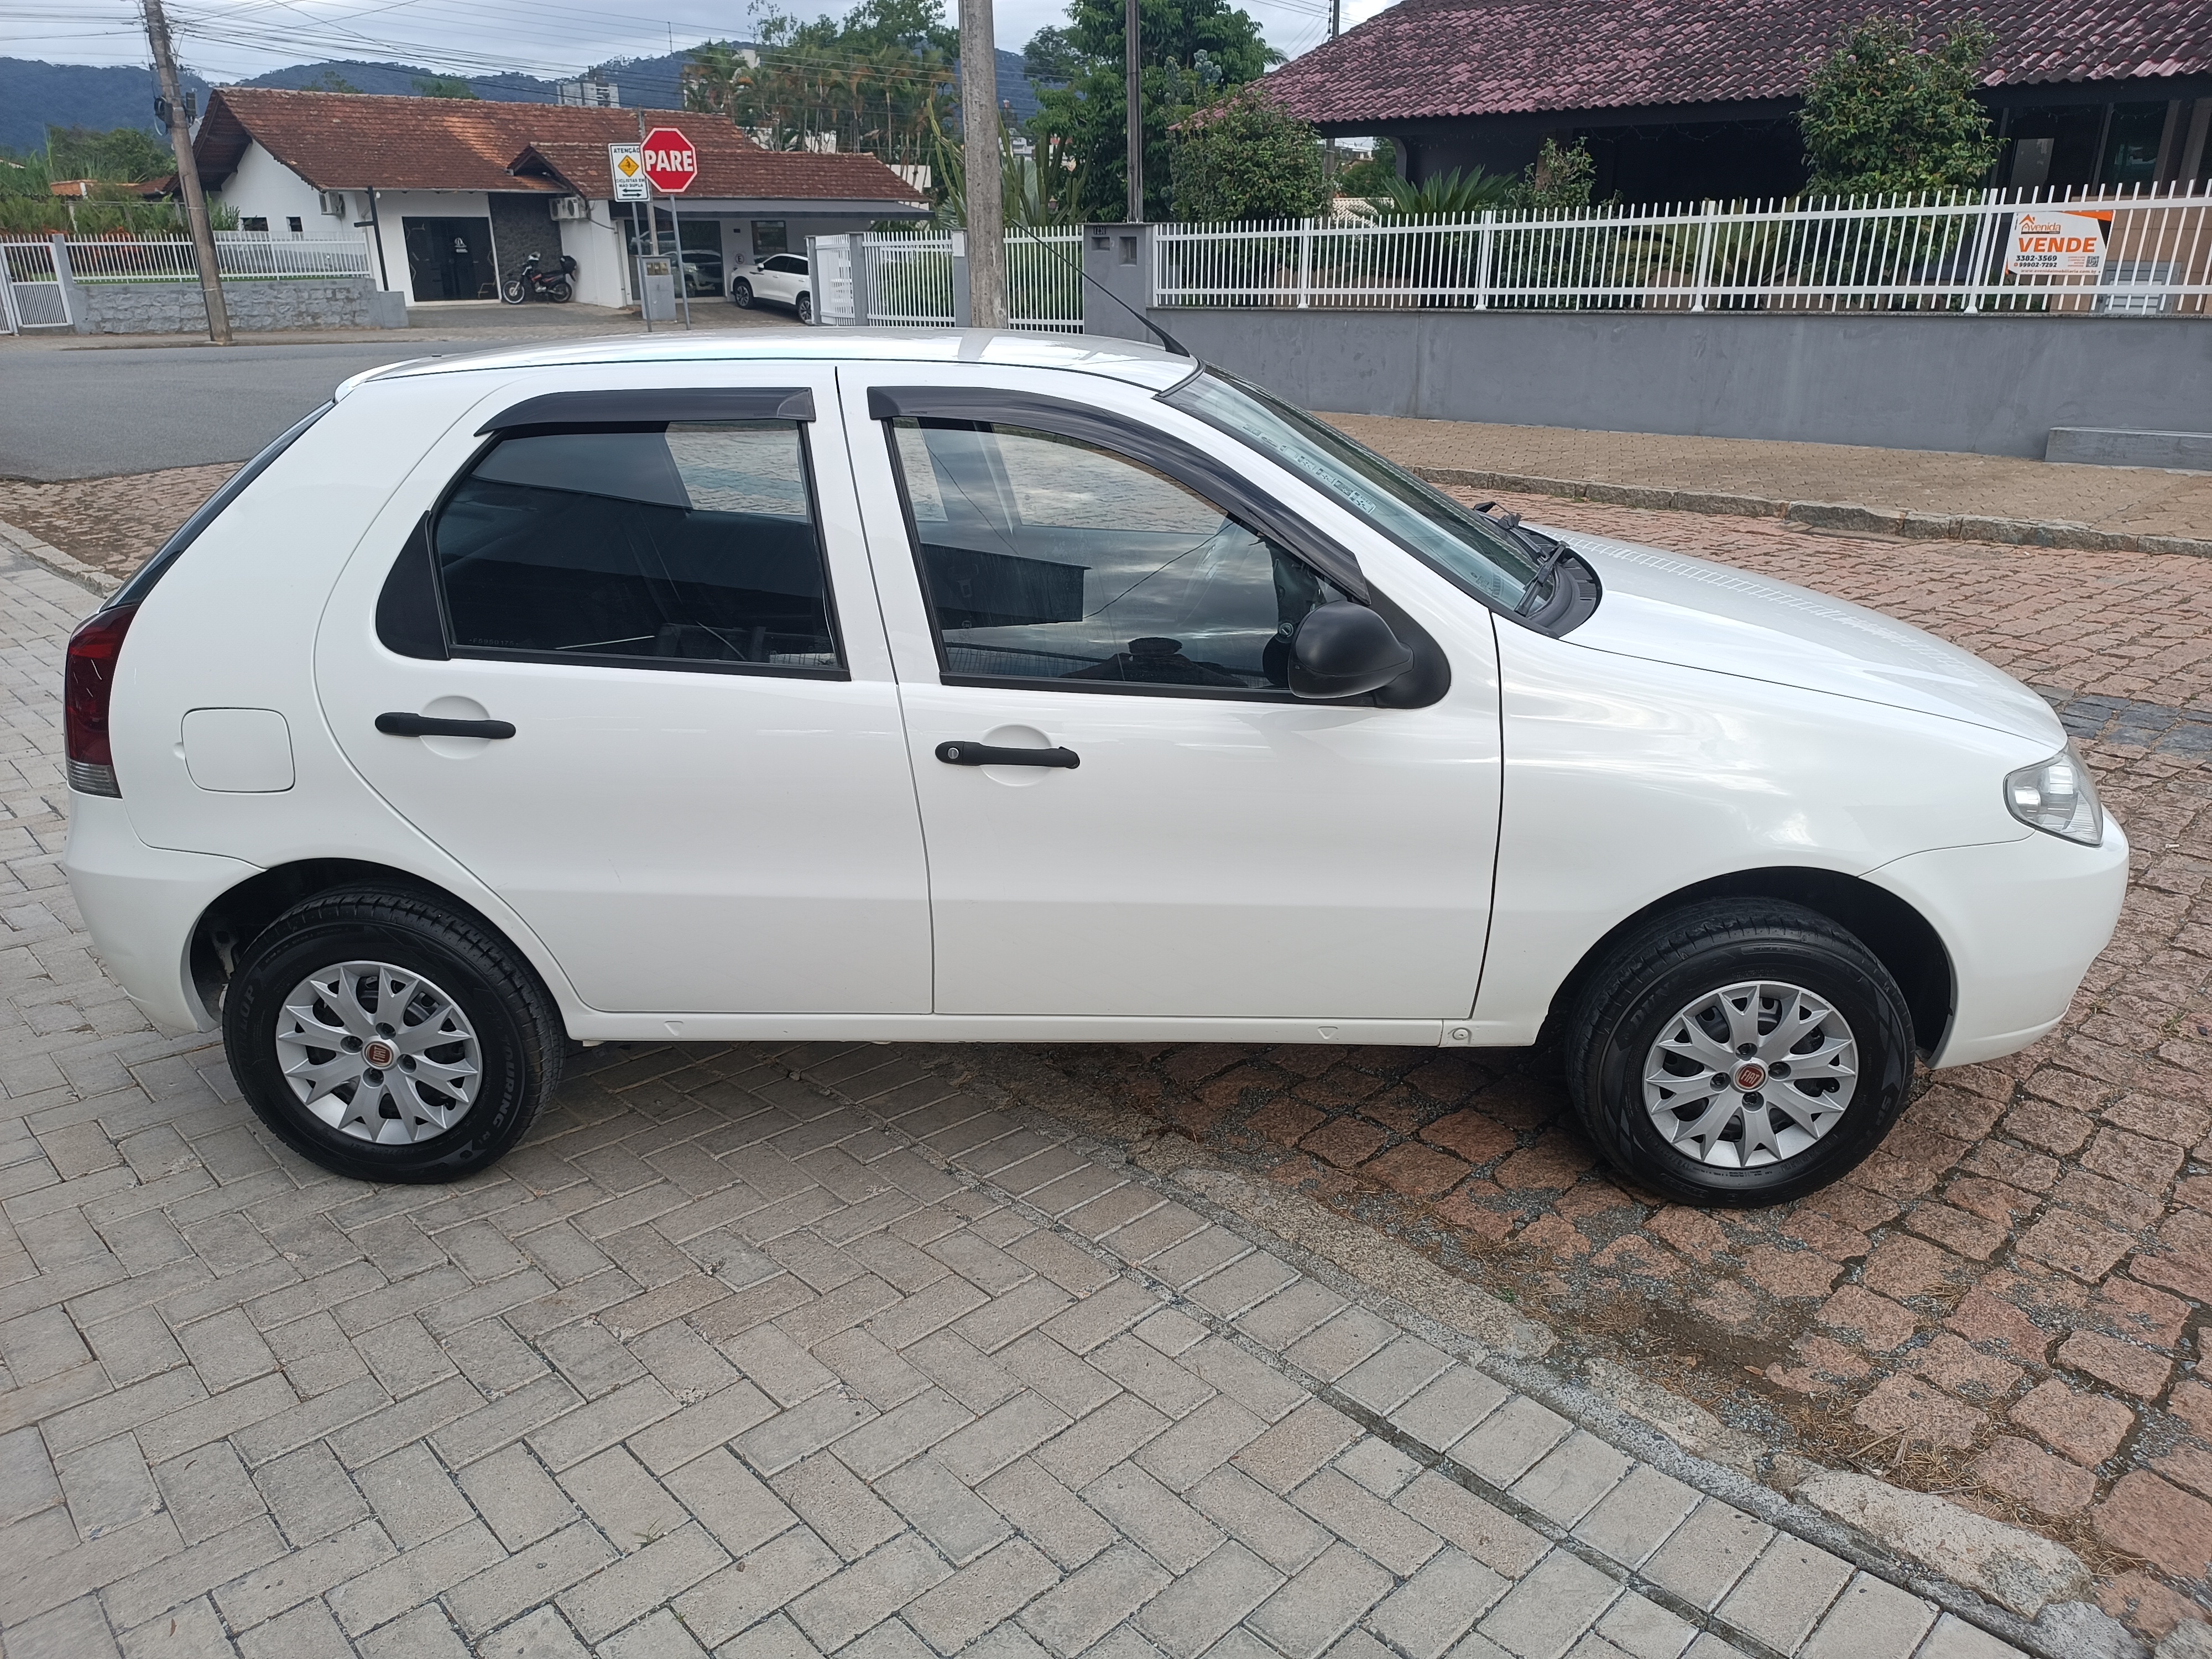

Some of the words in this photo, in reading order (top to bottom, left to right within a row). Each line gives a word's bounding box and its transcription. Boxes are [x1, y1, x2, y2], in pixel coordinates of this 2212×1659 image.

[644, 150, 693, 171] PARE
[2021, 220, 2061, 231] Avenida
[2018, 237, 2097, 253] VENDE
[373, 1046, 387, 1062] FIAT
[1740, 1070, 1760, 1084] FIAT
